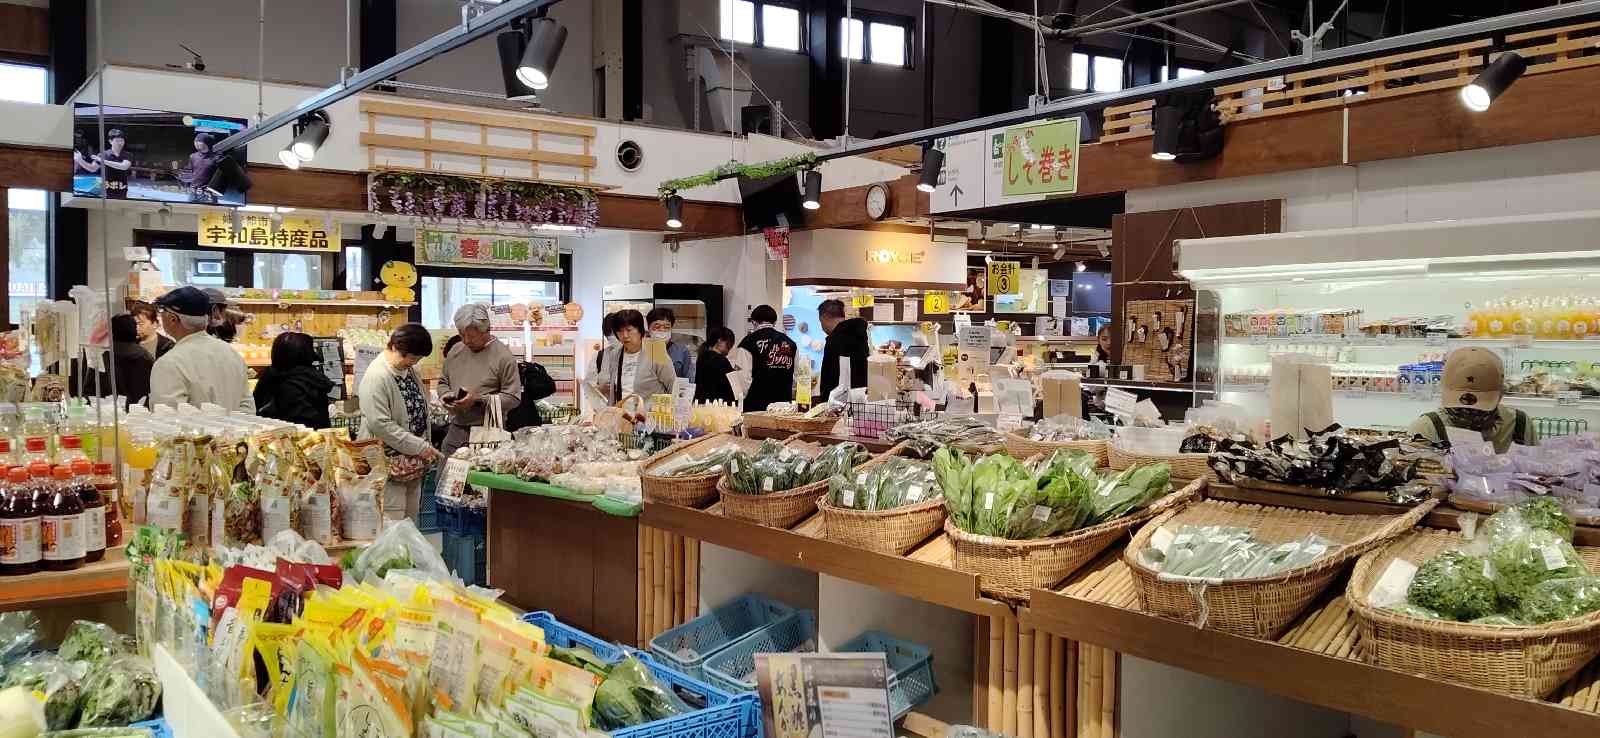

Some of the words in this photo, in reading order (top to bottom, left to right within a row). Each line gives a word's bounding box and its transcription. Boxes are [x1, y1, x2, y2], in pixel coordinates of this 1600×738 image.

[206, 224, 329, 249] 宇和島特産品
[991, 262, 1017, 276] お会計
